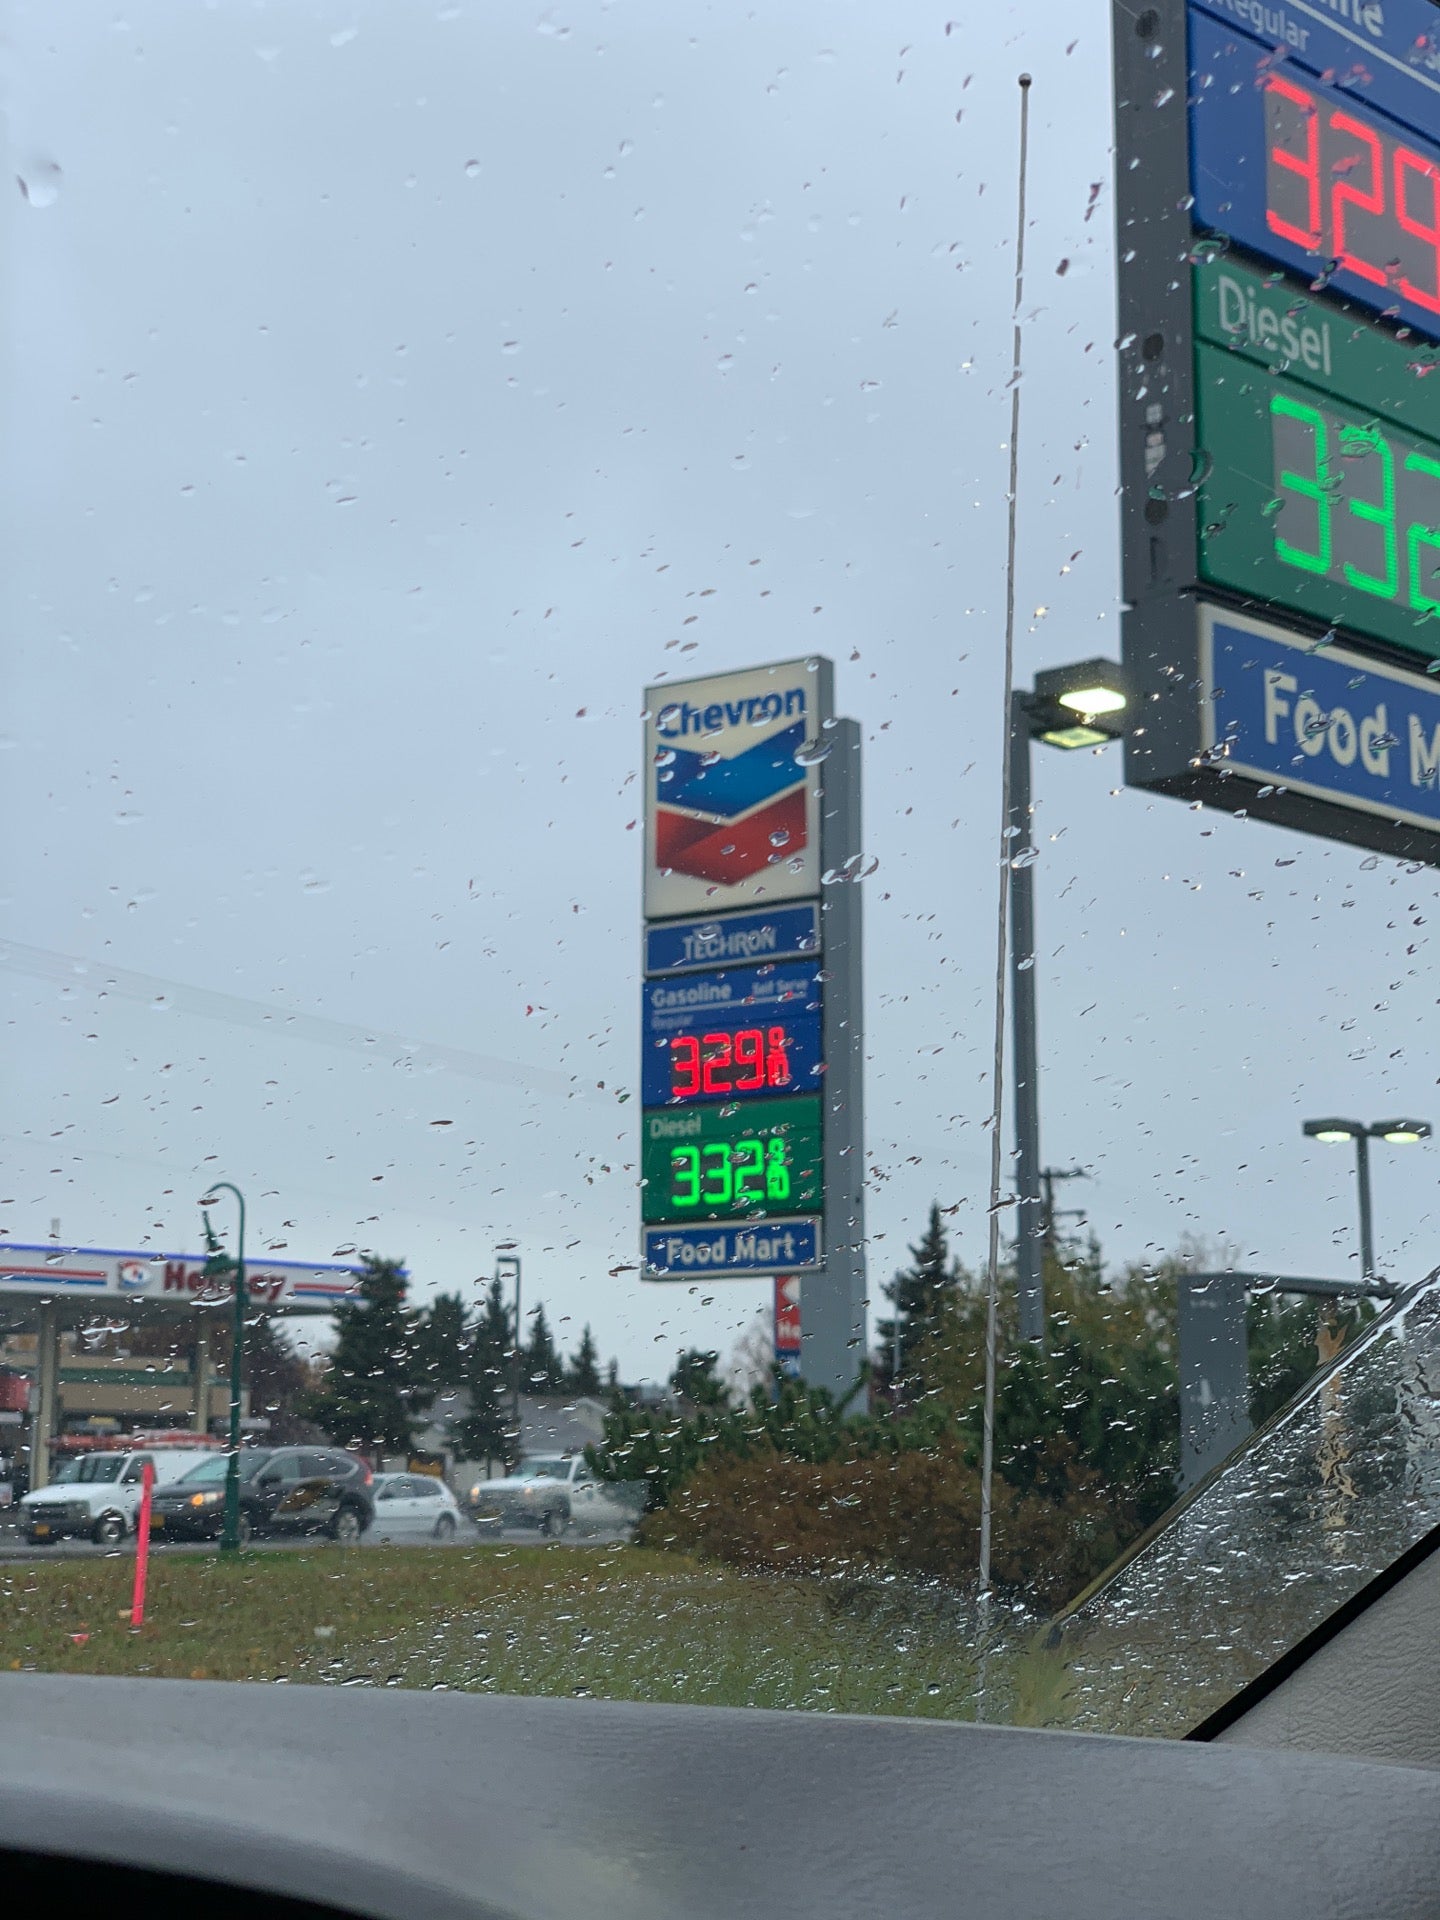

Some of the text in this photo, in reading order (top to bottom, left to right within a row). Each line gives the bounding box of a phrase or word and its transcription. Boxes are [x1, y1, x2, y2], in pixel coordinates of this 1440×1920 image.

[1218, 275, 1332, 376] Diesel
[655, 687, 806, 738] Chevron
[1264, 669, 1390, 778] Food
[651, 982, 733, 1008] Gasoline
[650, 1115, 702, 1139] Diesel
[666, 1230, 796, 1266] Food Mart
